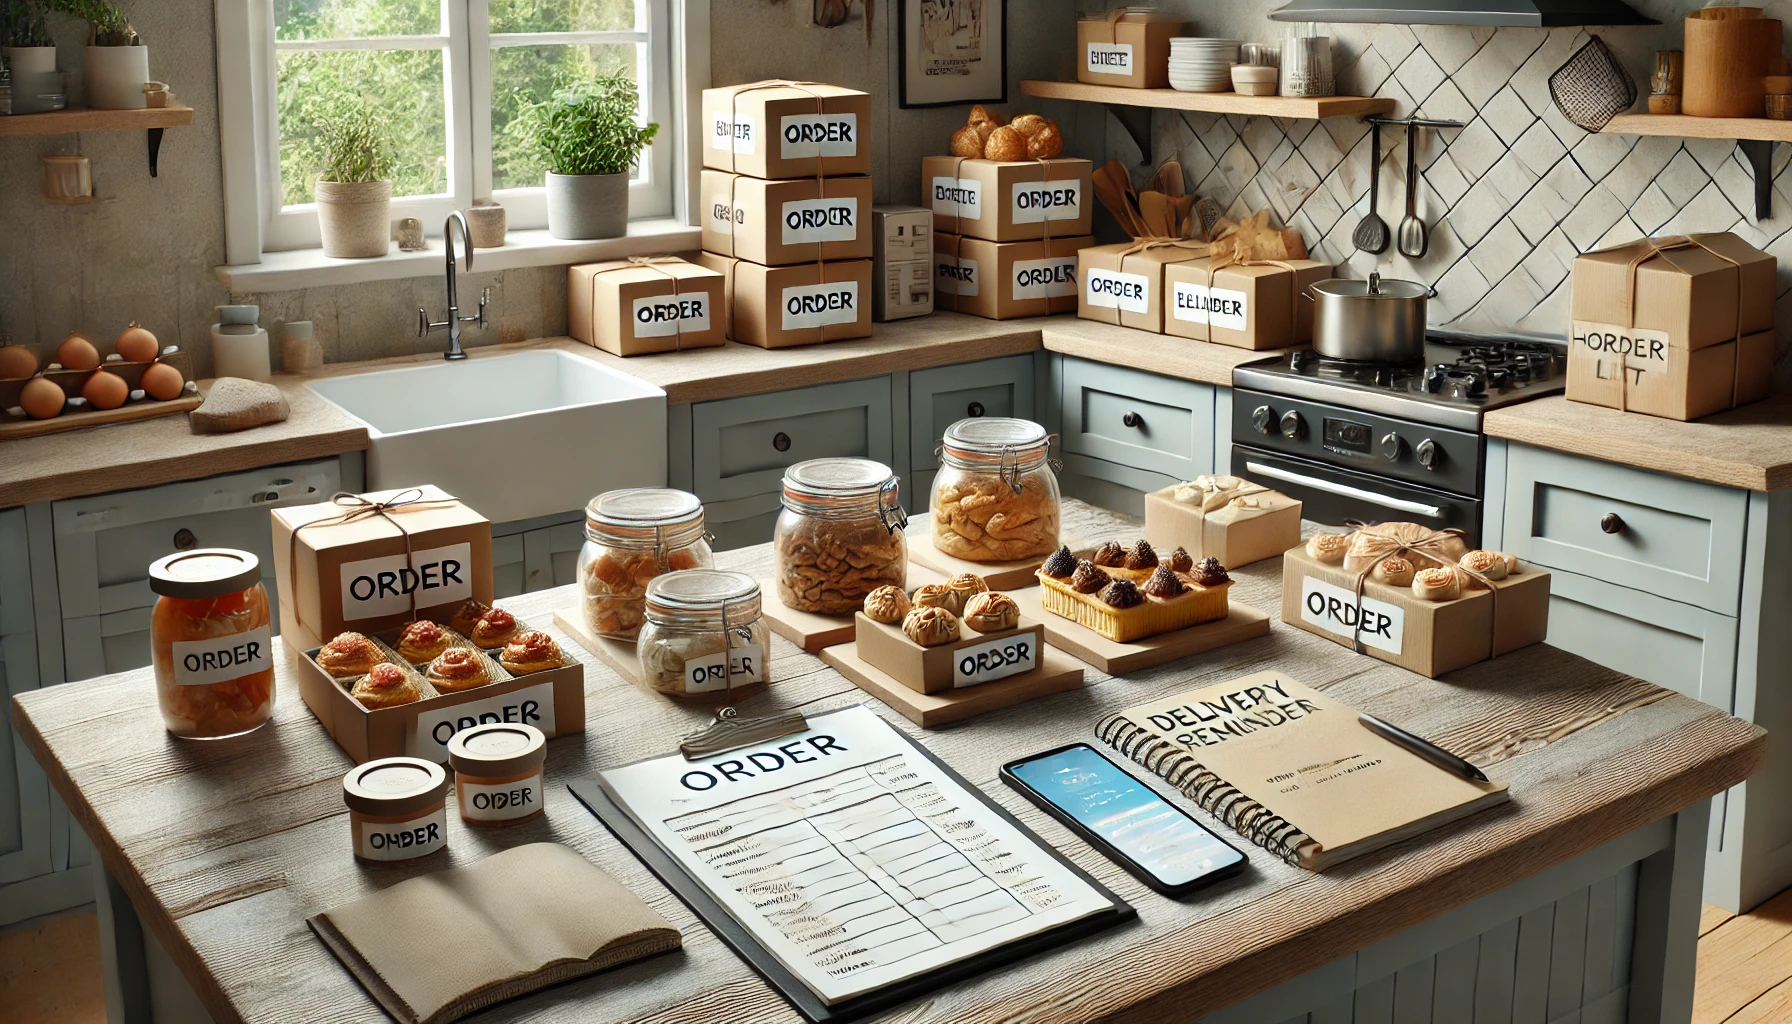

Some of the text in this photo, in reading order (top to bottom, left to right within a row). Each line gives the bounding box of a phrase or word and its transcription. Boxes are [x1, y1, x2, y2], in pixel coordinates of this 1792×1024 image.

[784, 122, 853, 144] ORDER
[787, 291, 853, 315] ORDER
[1091, 277, 1143, 301] ORDER
[637, 300, 703, 323] ORDER
[350, 559, 464, 602] ORDER
[1307, 591, 1392, 640] ORDER
[183, 641, 262, 673] ORDER
[680, 735, 849, 791] ORDER
